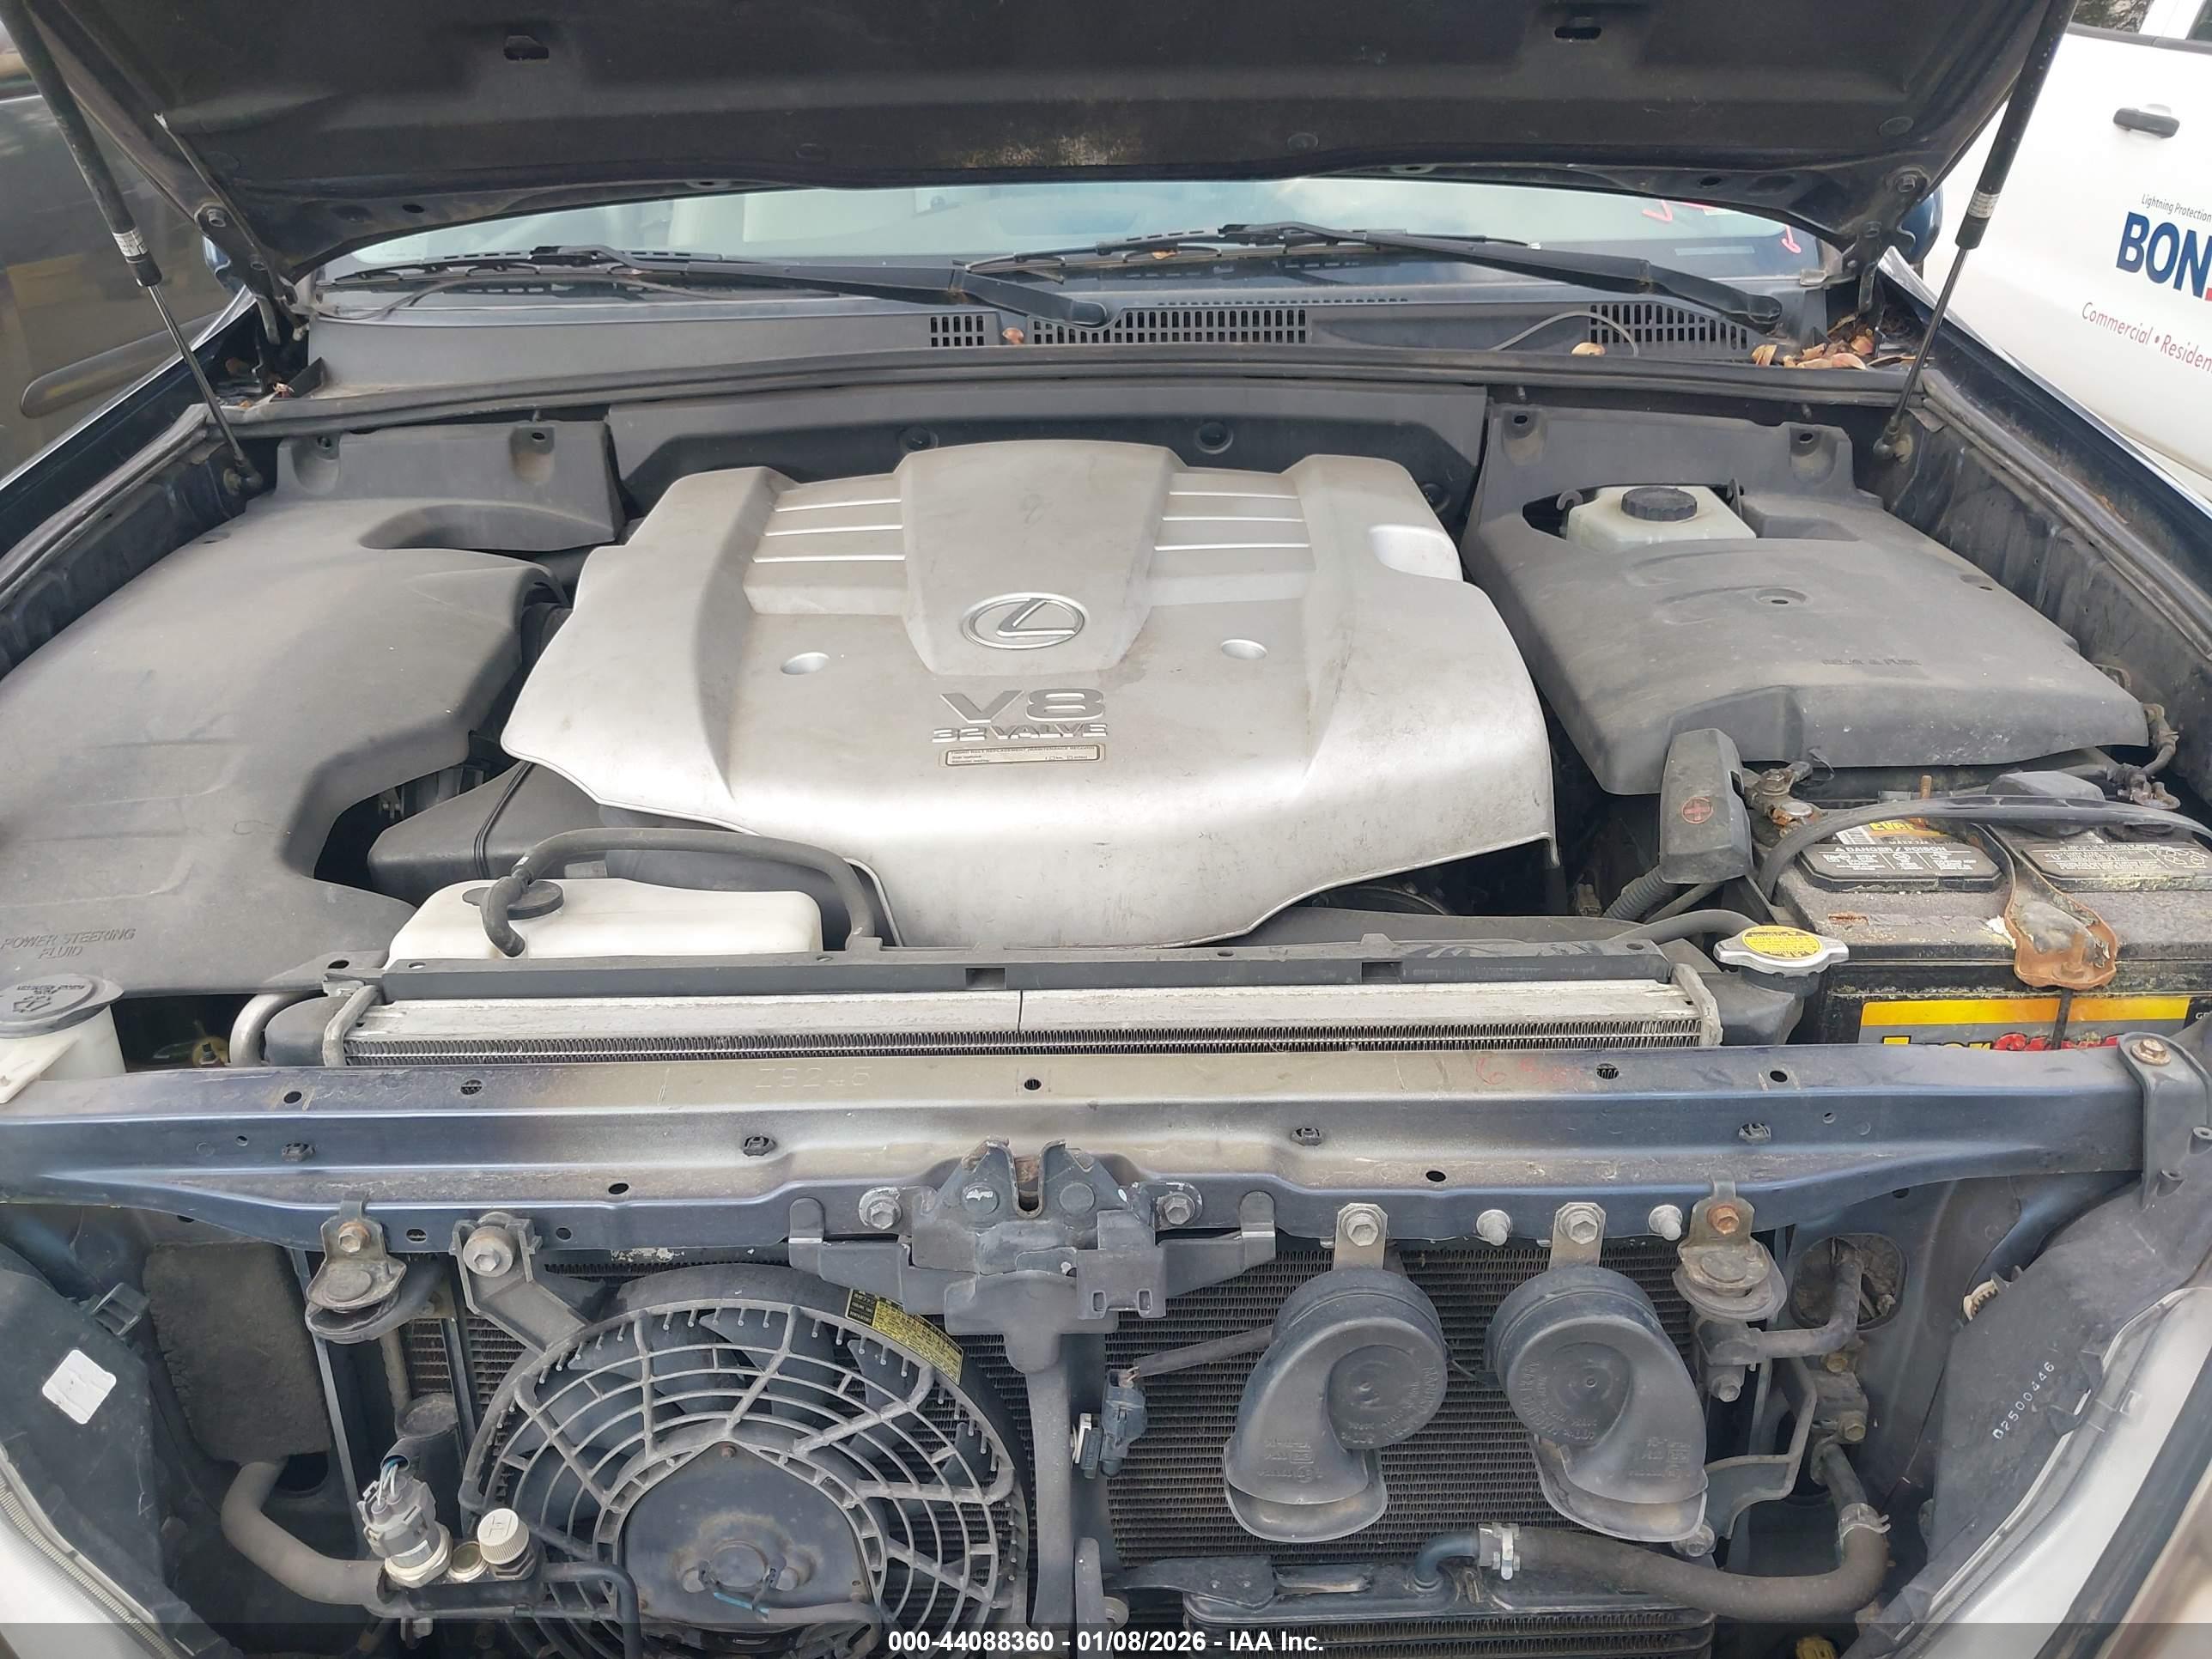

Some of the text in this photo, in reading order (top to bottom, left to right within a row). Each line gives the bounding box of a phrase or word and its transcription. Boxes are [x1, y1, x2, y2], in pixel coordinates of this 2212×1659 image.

[2141, 193, 2212, 222] Lightning Protection
[2081, 301, 2153, 346] Commercial
[939, 688, 1106, 724] V8
[989, 722, 1109, 740] VALVE
[1, 927, 137, 950] POWER STEERING
[38, 945, 83, 960] FLUID
